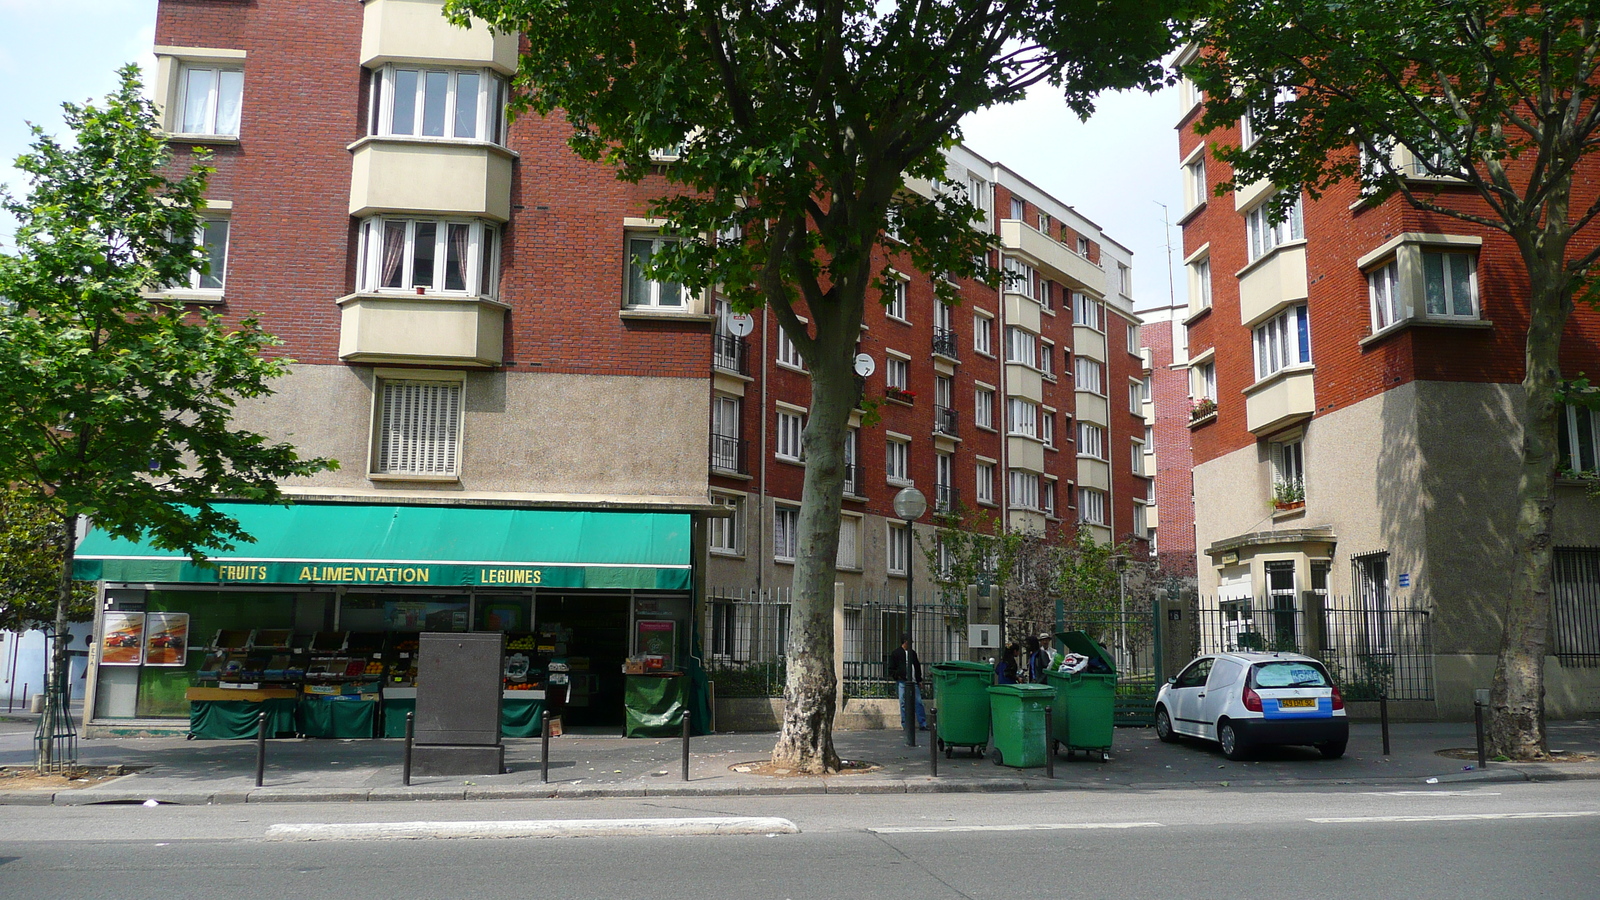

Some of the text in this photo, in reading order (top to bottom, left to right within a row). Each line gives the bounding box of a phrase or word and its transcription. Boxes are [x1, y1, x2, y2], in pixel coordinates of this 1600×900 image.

[219, 565, 267, 580] FRUITS
[298, 566, 430, 583] ALIMENTATION
[481, 569, 542, 584] LEGUMES
